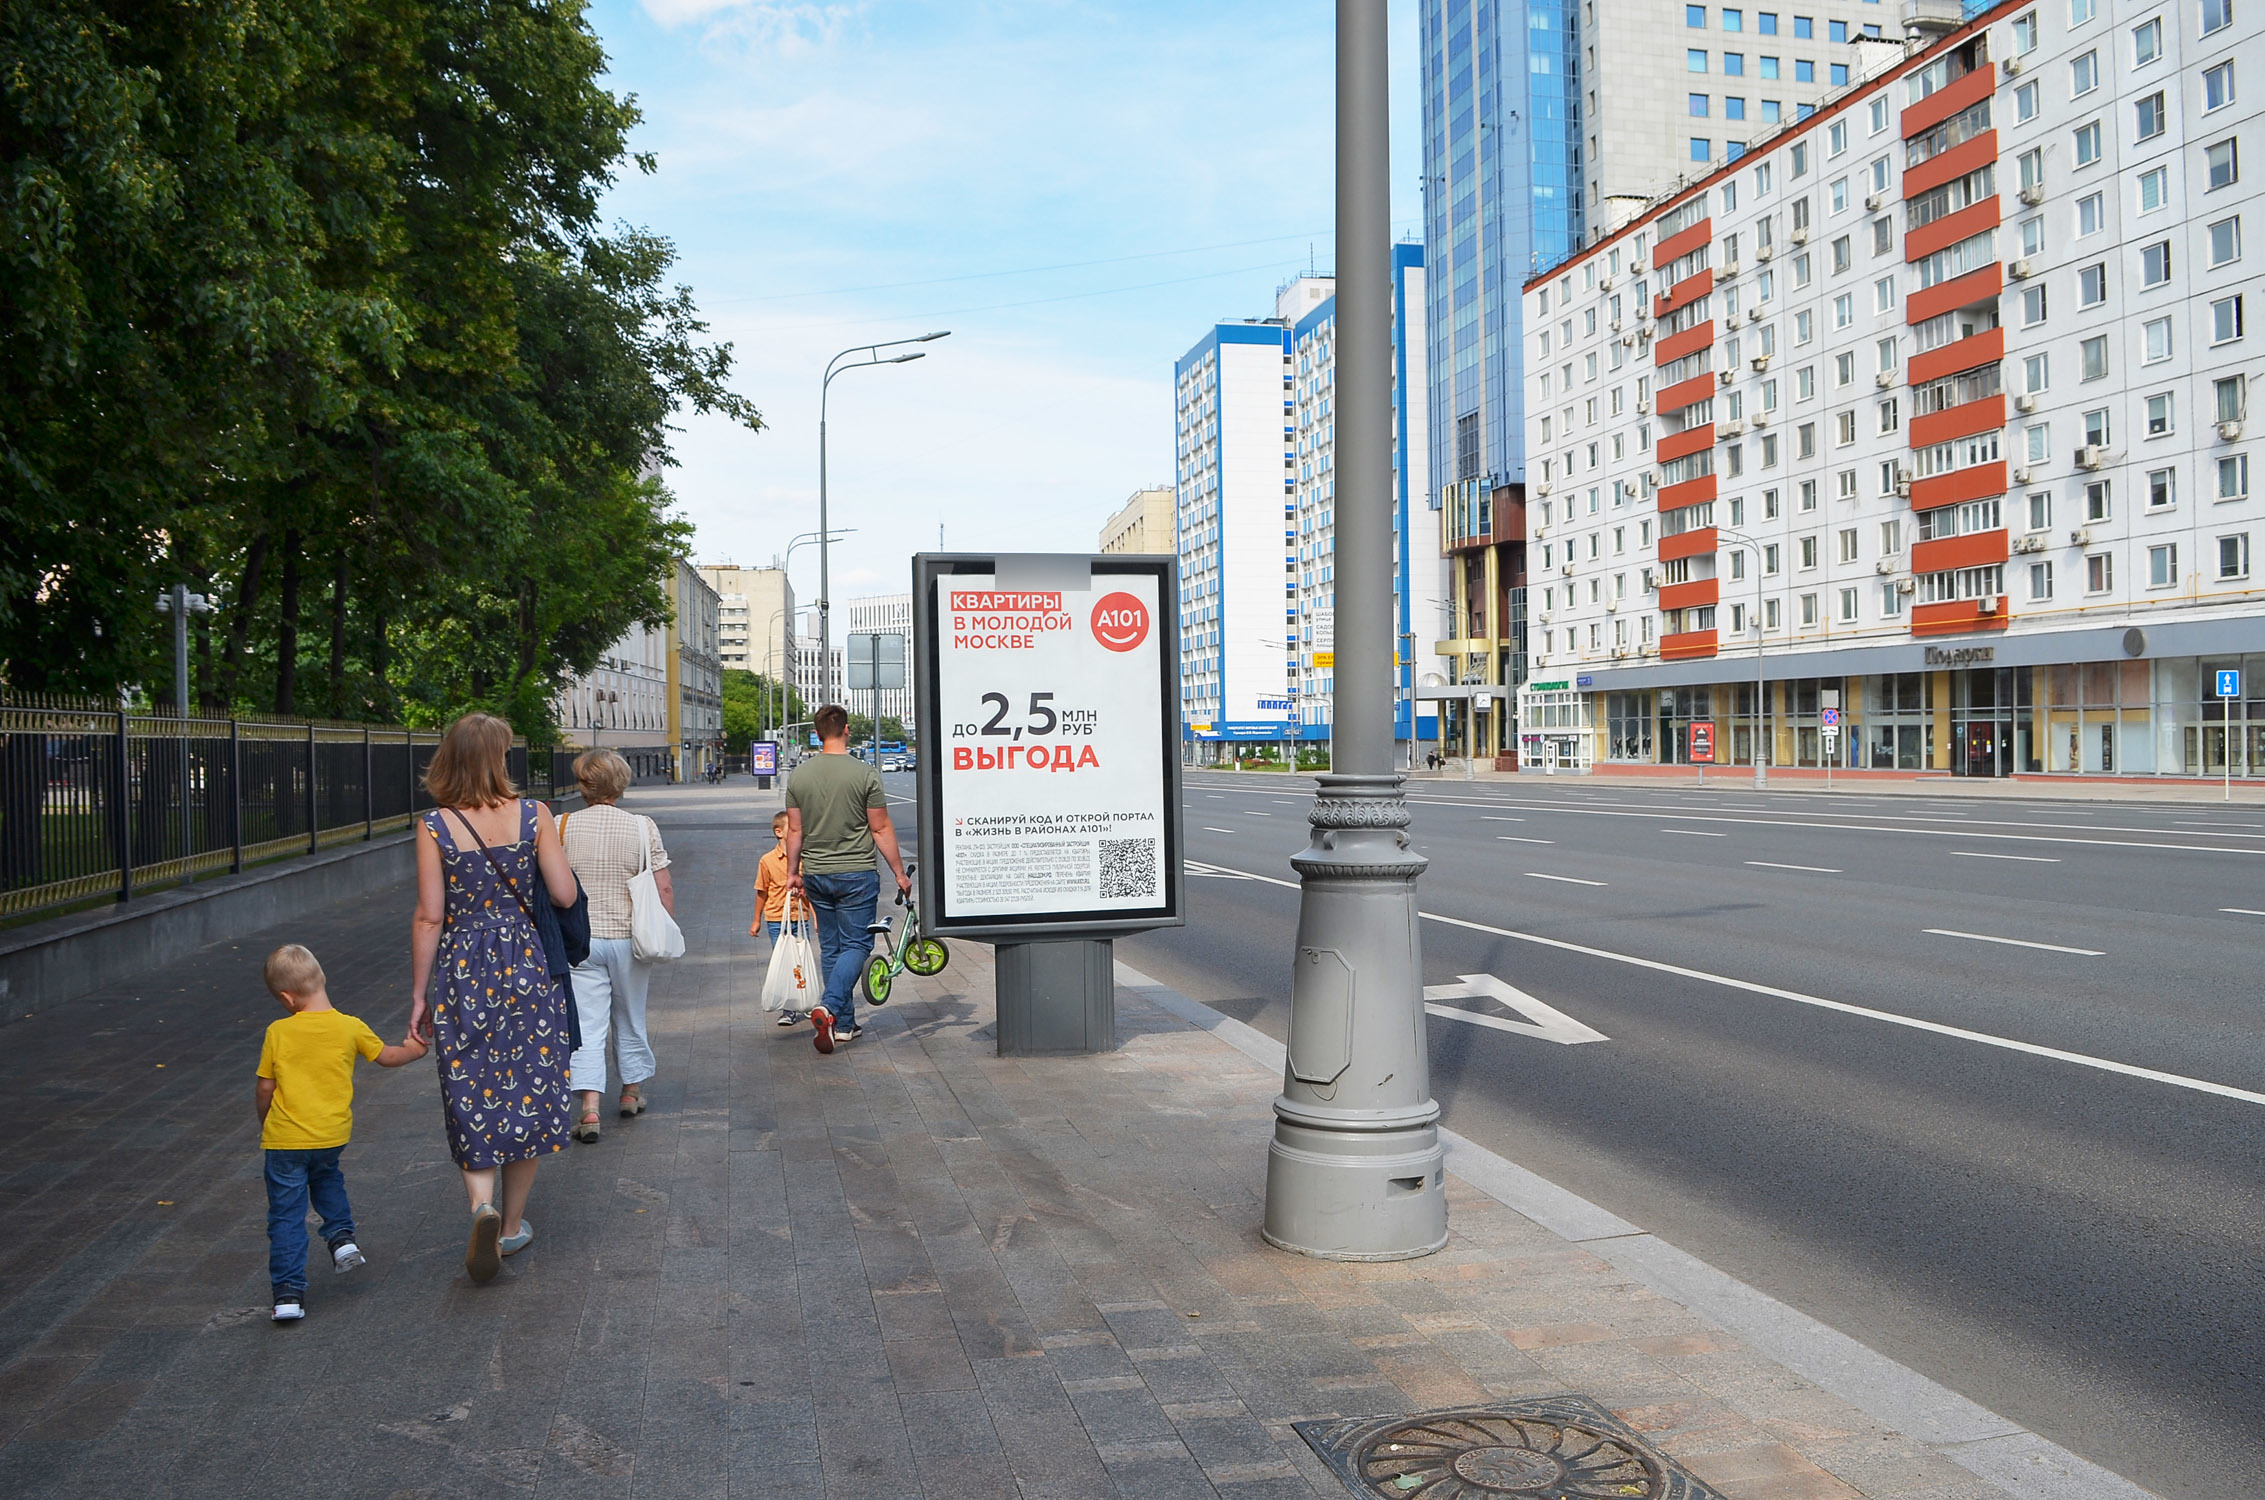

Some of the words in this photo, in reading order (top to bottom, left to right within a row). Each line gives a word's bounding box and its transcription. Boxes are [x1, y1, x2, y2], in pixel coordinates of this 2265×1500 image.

[952, 594, 1060, 610] КВАРТИРЫ
[954, 616, 966, 631] В
[972, 612, 1072, 632] МОЛОДОЙ
[1096, 609, 1142, 628] А101
[954, 635, 1035, 649] МОСКВЕ
[1924, 646, 1994, 667] Подарки
[952, 724, 978, 738] ДО
[981, 692, 1057, 741] 2,5
[1062, 710, 1097, 722] МЛН
[953, 744, 1100, 773] ВЫГОДА
[967, 813, 1026, 826] СКАНИРУЙ
[1029, 815, 1053, 825] КОД
[1055, 815, 1063, 823] И
[1066, 812, 1110, 823] ОТКРОЙ
[1113, 812, 1154, 822] ПОРТАЛ
[955, 828, 962, 837] В
[965, 827, 1012, 836] «ЖИЗНЬ
[1014, 826, 1022, 835] В
[1025, 824, 1076, 835] РАЙОНАХ
